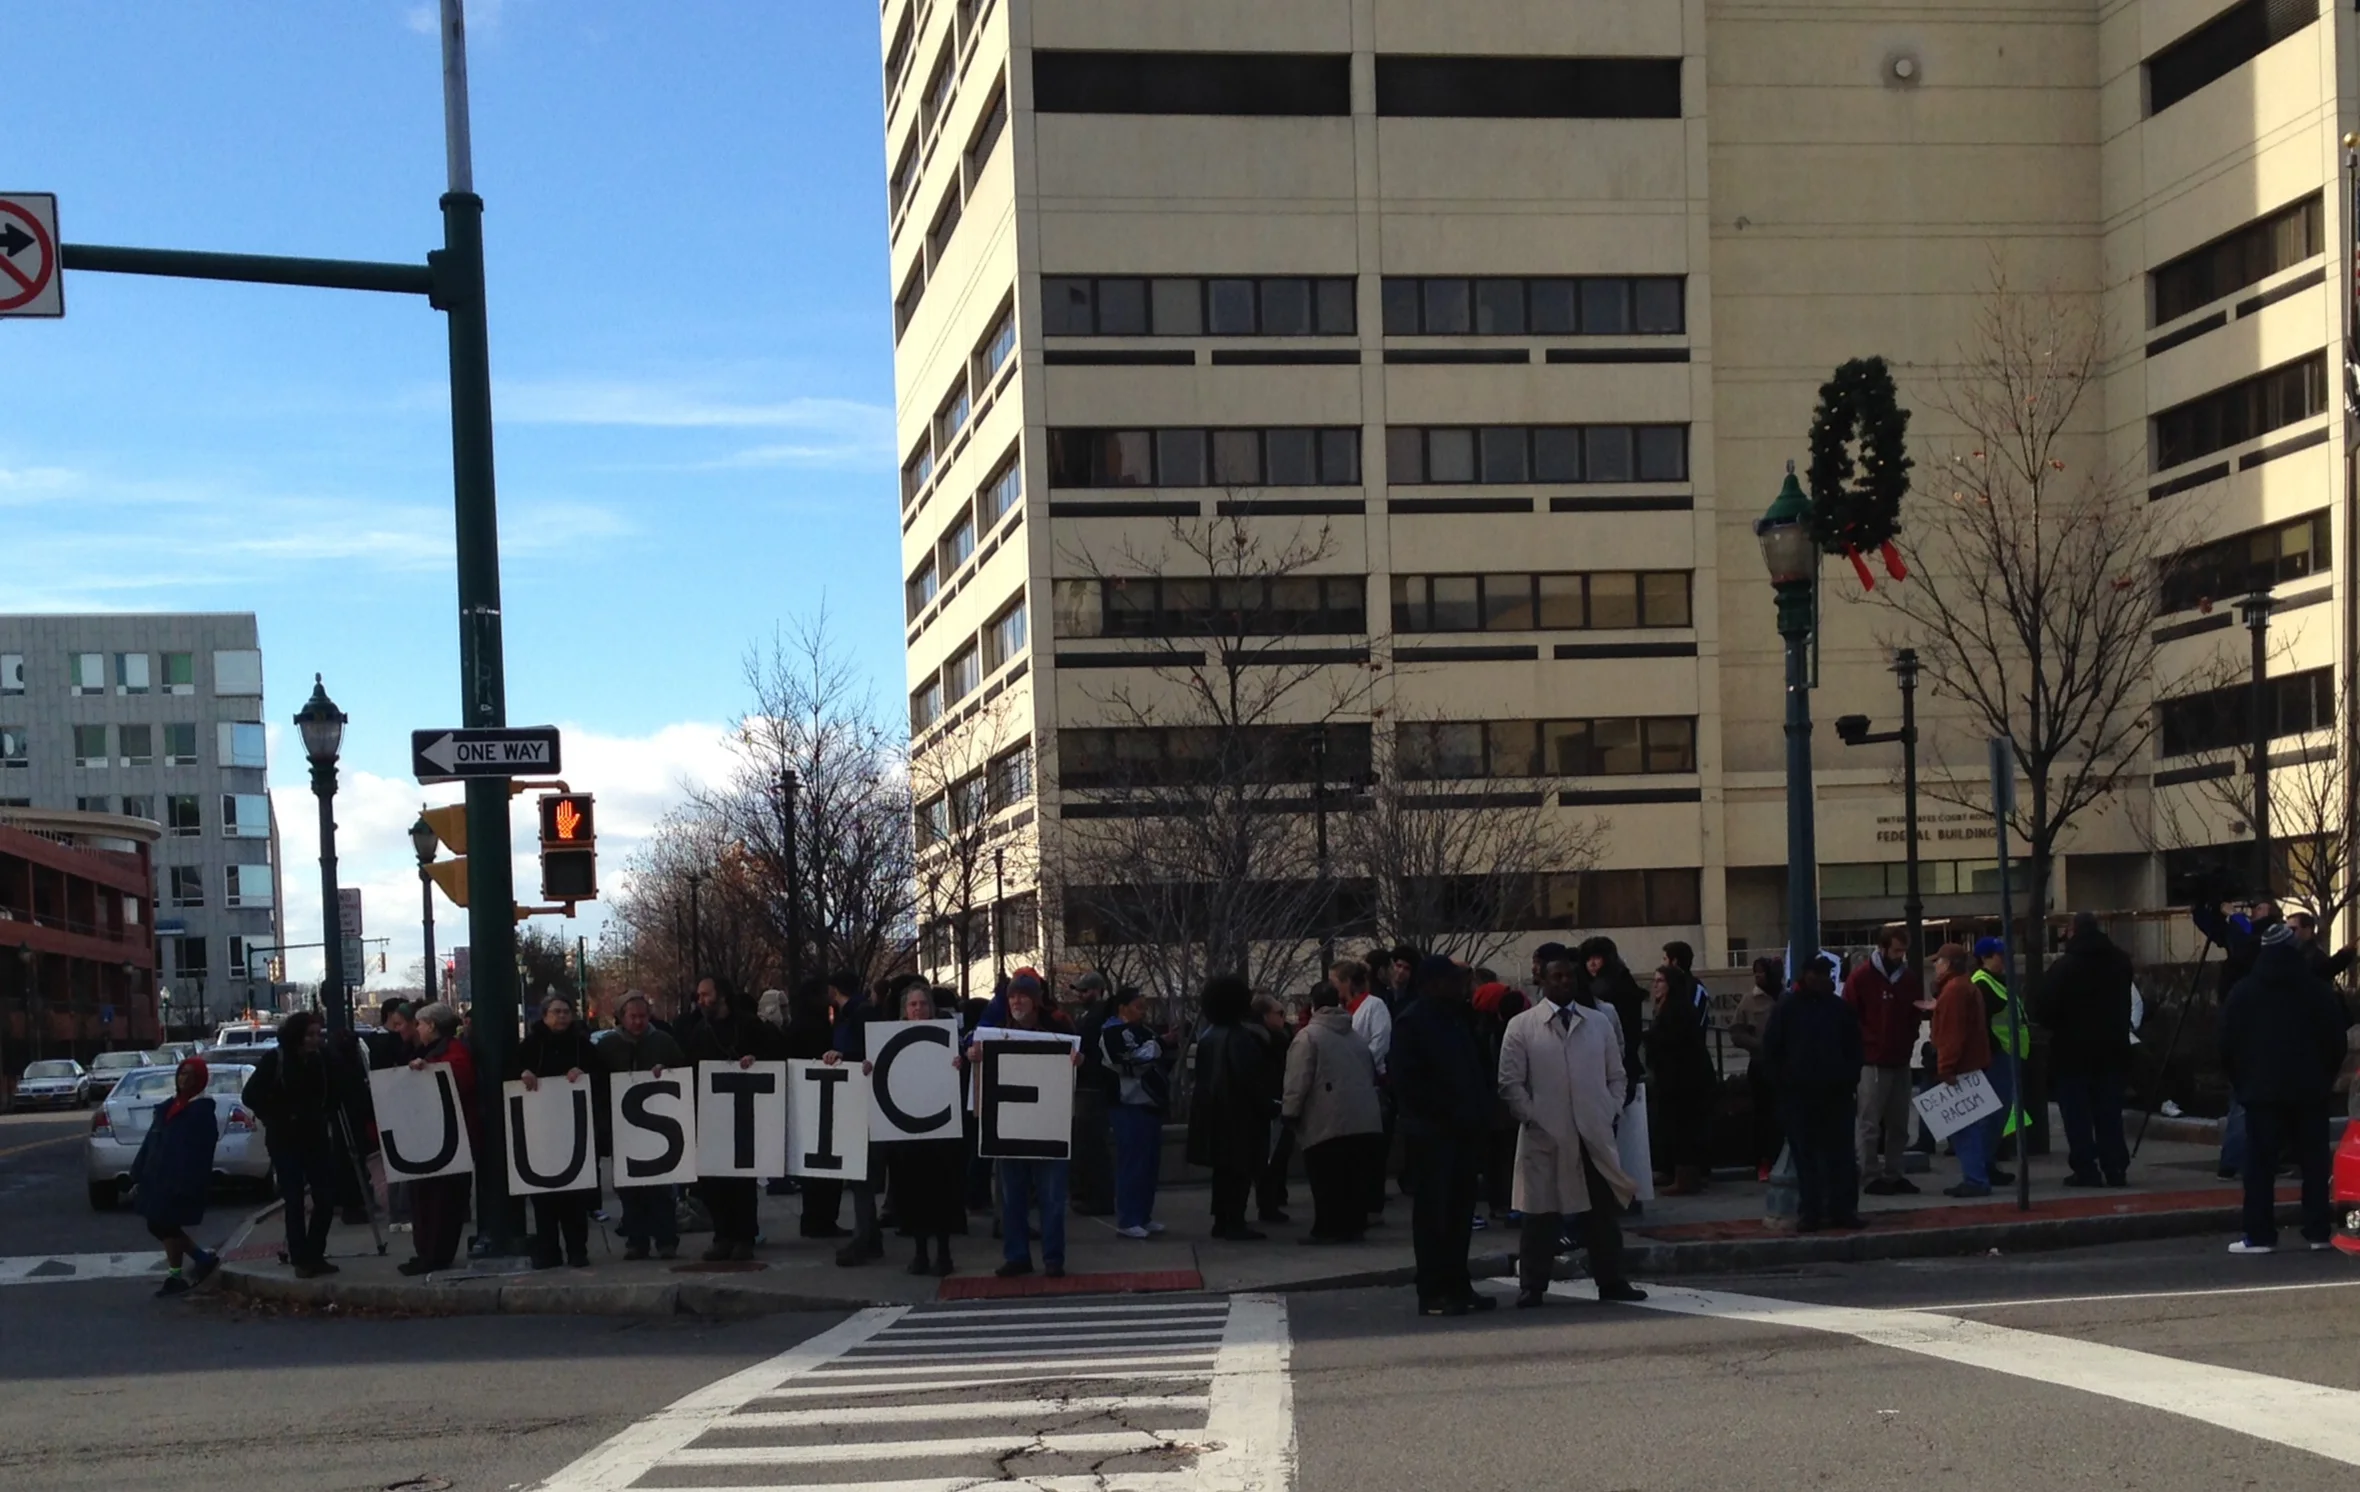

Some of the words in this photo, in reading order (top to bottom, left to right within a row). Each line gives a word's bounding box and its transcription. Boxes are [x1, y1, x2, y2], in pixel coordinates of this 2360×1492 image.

[457, 743, 496, 761] ONE
[503, 742, 543, 760] WAY
[1939, 814, 1967, 822] COURT
[1877, 829, 1931, 842] FEDEAL
[1938, 827, 1998, 840] BUILDING
[1920, 1083, 1963, 1113] DEATH
[1964, 1074, 1981, 1088] TO
[1941, 1093, 1985, 1124] RACISM
